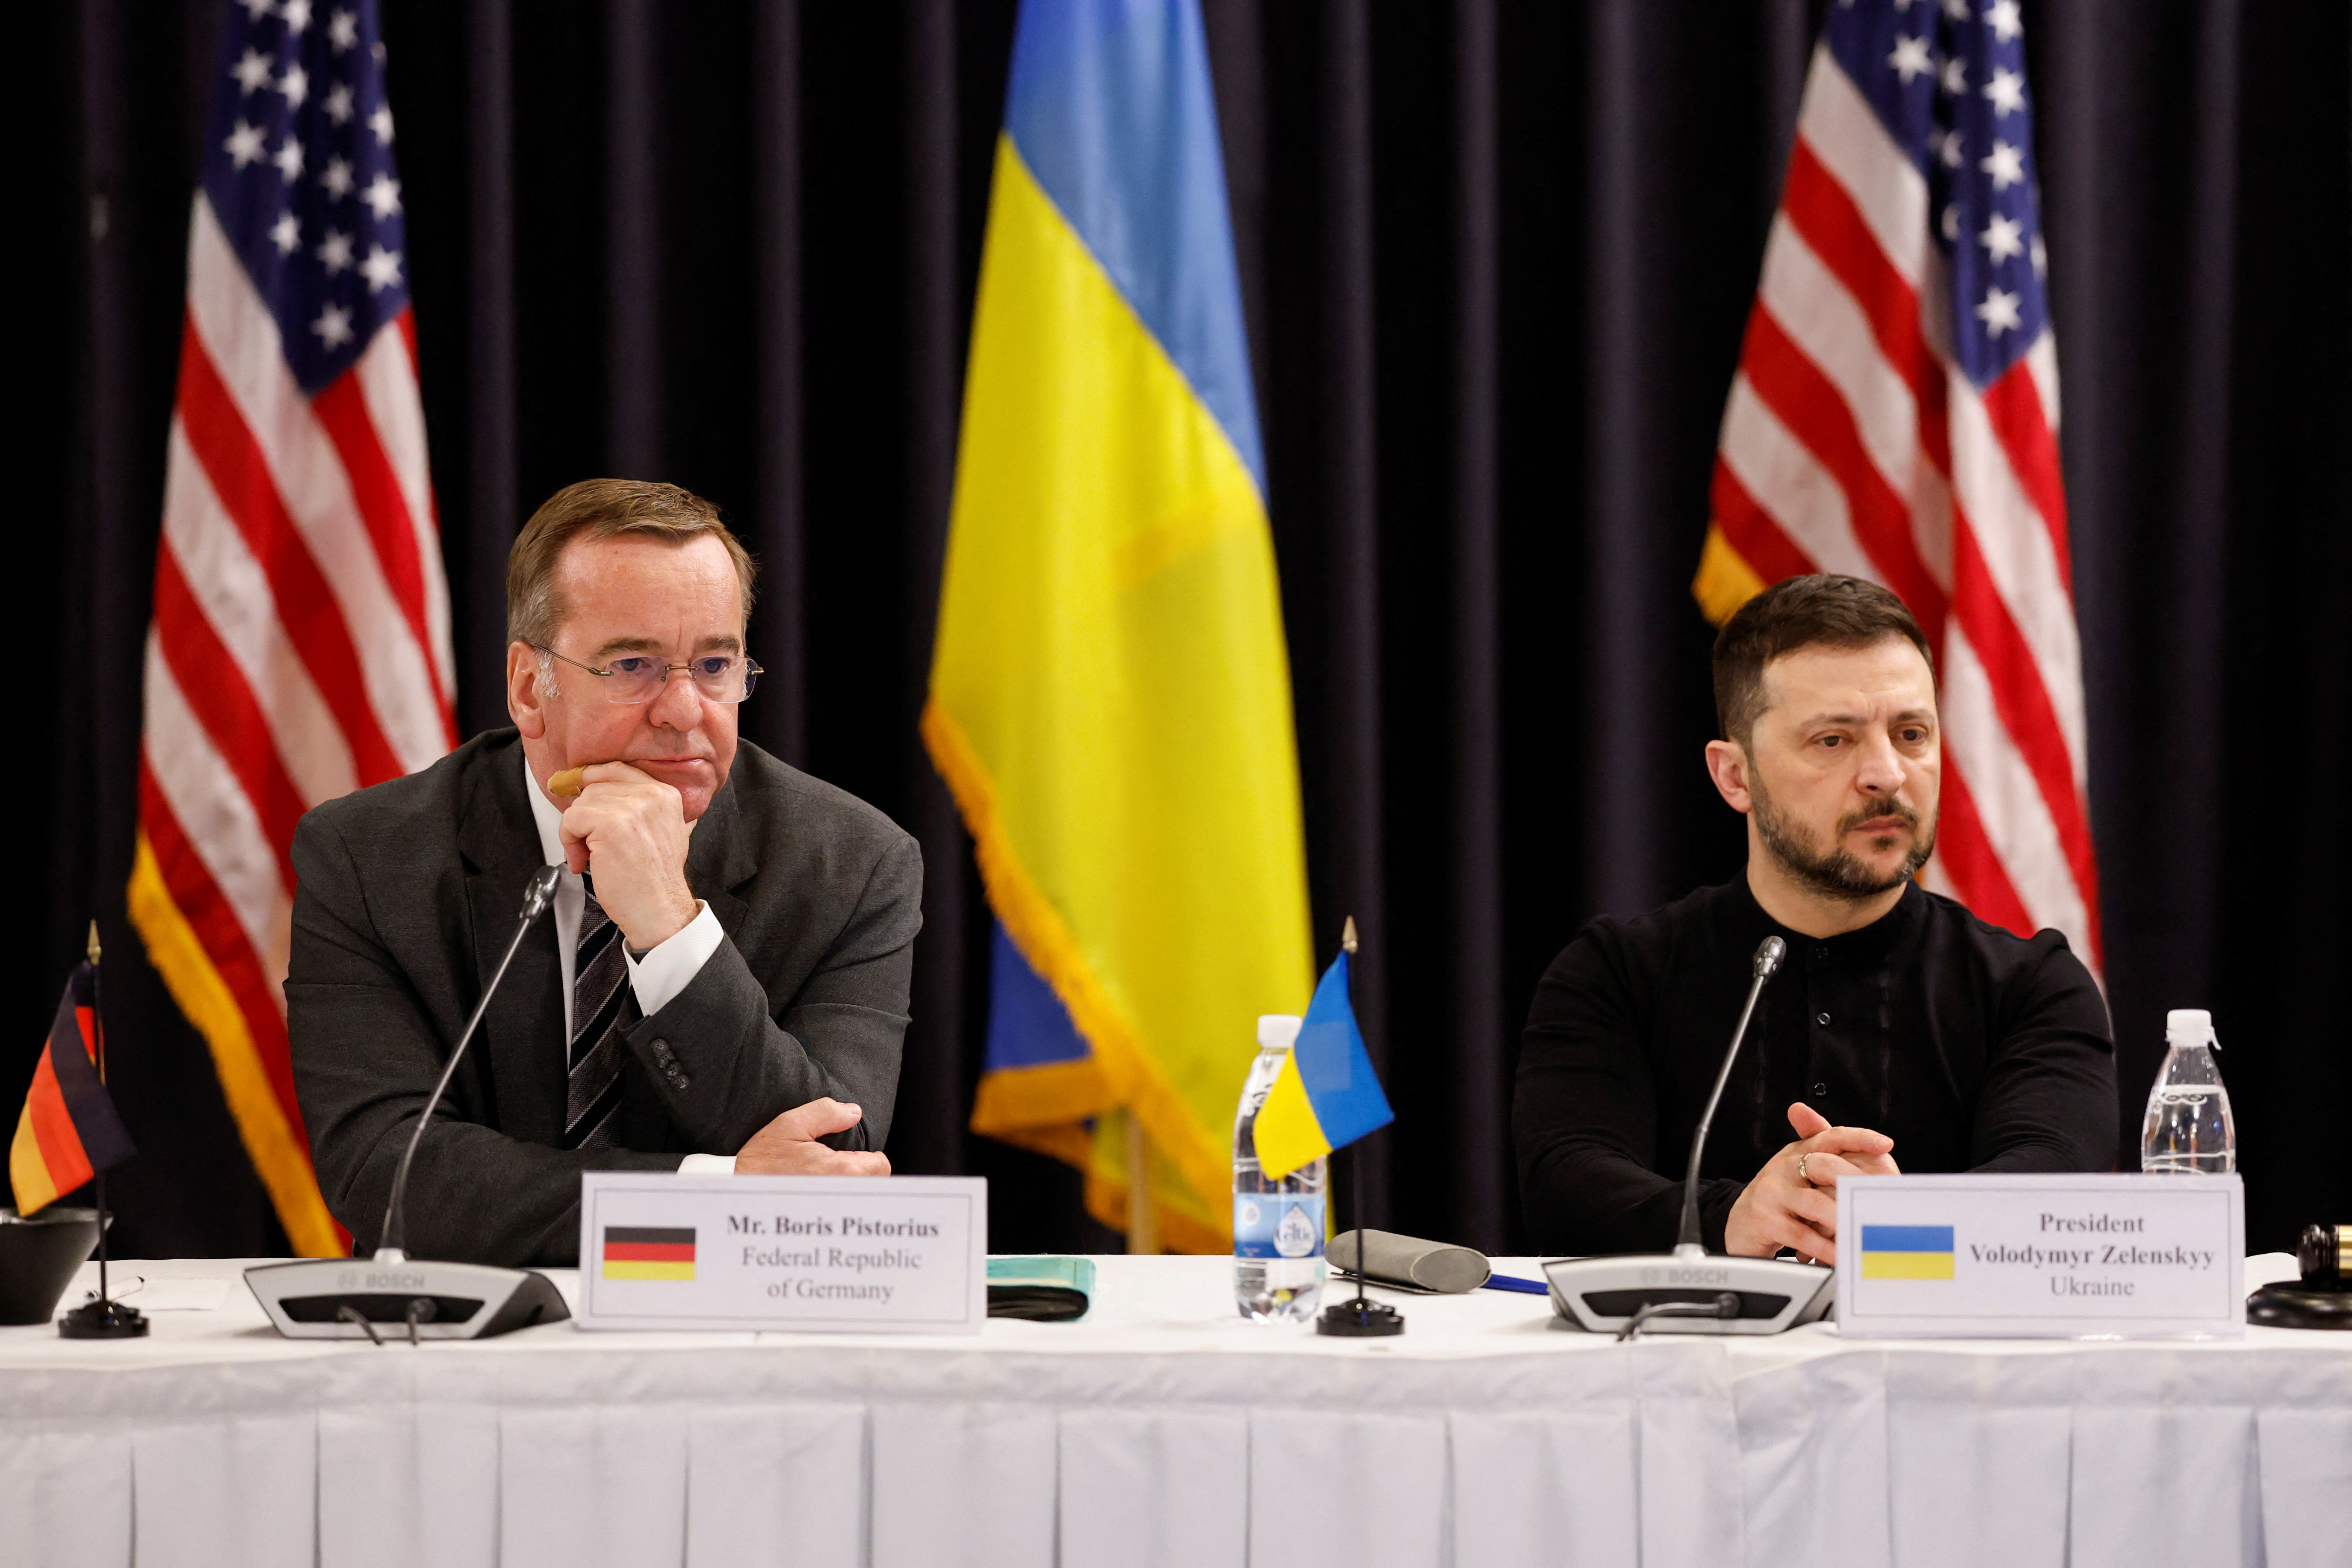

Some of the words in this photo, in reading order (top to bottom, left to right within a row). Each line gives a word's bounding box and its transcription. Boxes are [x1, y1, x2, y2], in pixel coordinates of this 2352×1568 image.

[729, 1216, 766, 1235] Mr.
[775, 1216, 833, 1236] Boris
[841, 1217, 940, 1236] Pistorius
[2040, 1213, 2144, 1233] President
[742, 1246, 819, 1267] Federal
[827, 1247, 923, 1273] Republic
[1970, 1243, 2094, 1269] Volodymyr
[2101, 1244, 2214, 1270] Zelenskyy
[366, 1274, 425, 1288] BOSCH
[1669, 1270, 1728, 1284] BOSCH
[2050, 1276, 2135, 1297] Ukraine
[767, 1278, 792, 1298] of
[796, 1278, 893, 1304] Germany
